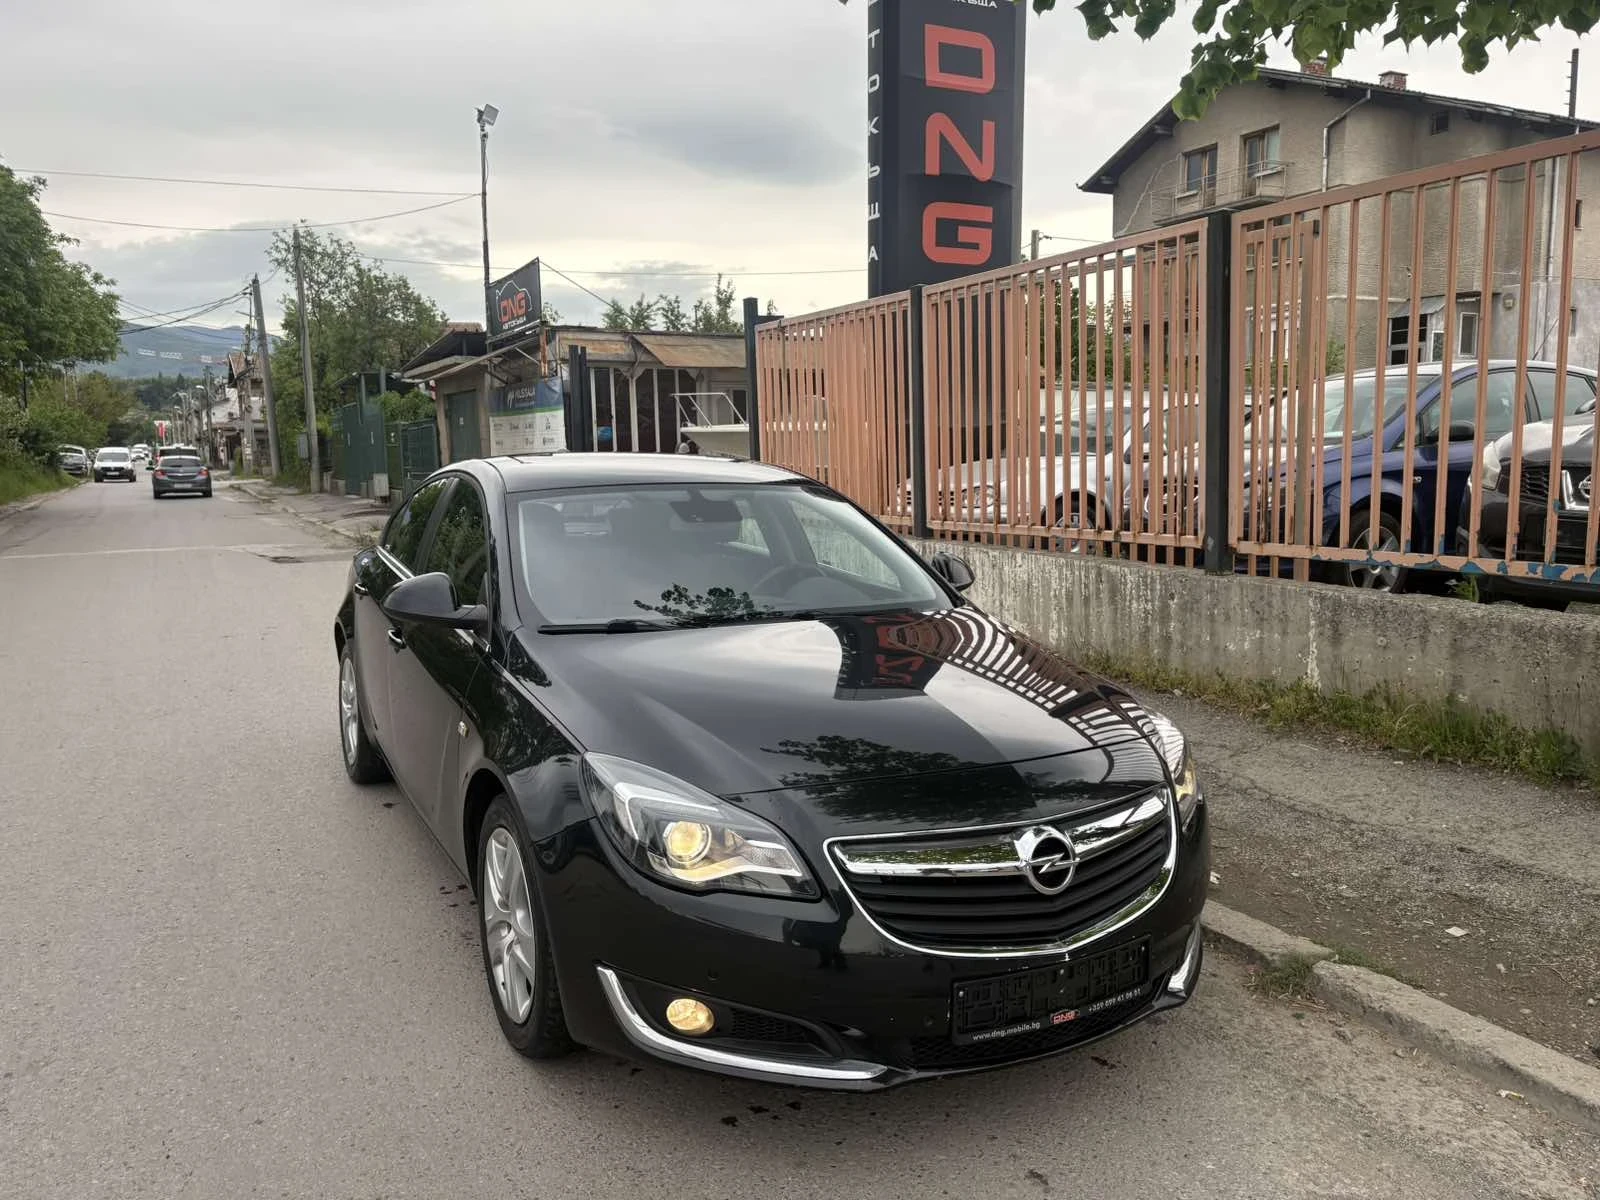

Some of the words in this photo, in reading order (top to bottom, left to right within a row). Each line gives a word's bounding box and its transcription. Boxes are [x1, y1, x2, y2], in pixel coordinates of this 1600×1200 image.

[922, 24, 995, 265] DNG
[501, 291, 526, 323] DNG
[972, 1021, 1041, 1041] www.dng.mobile.bg
